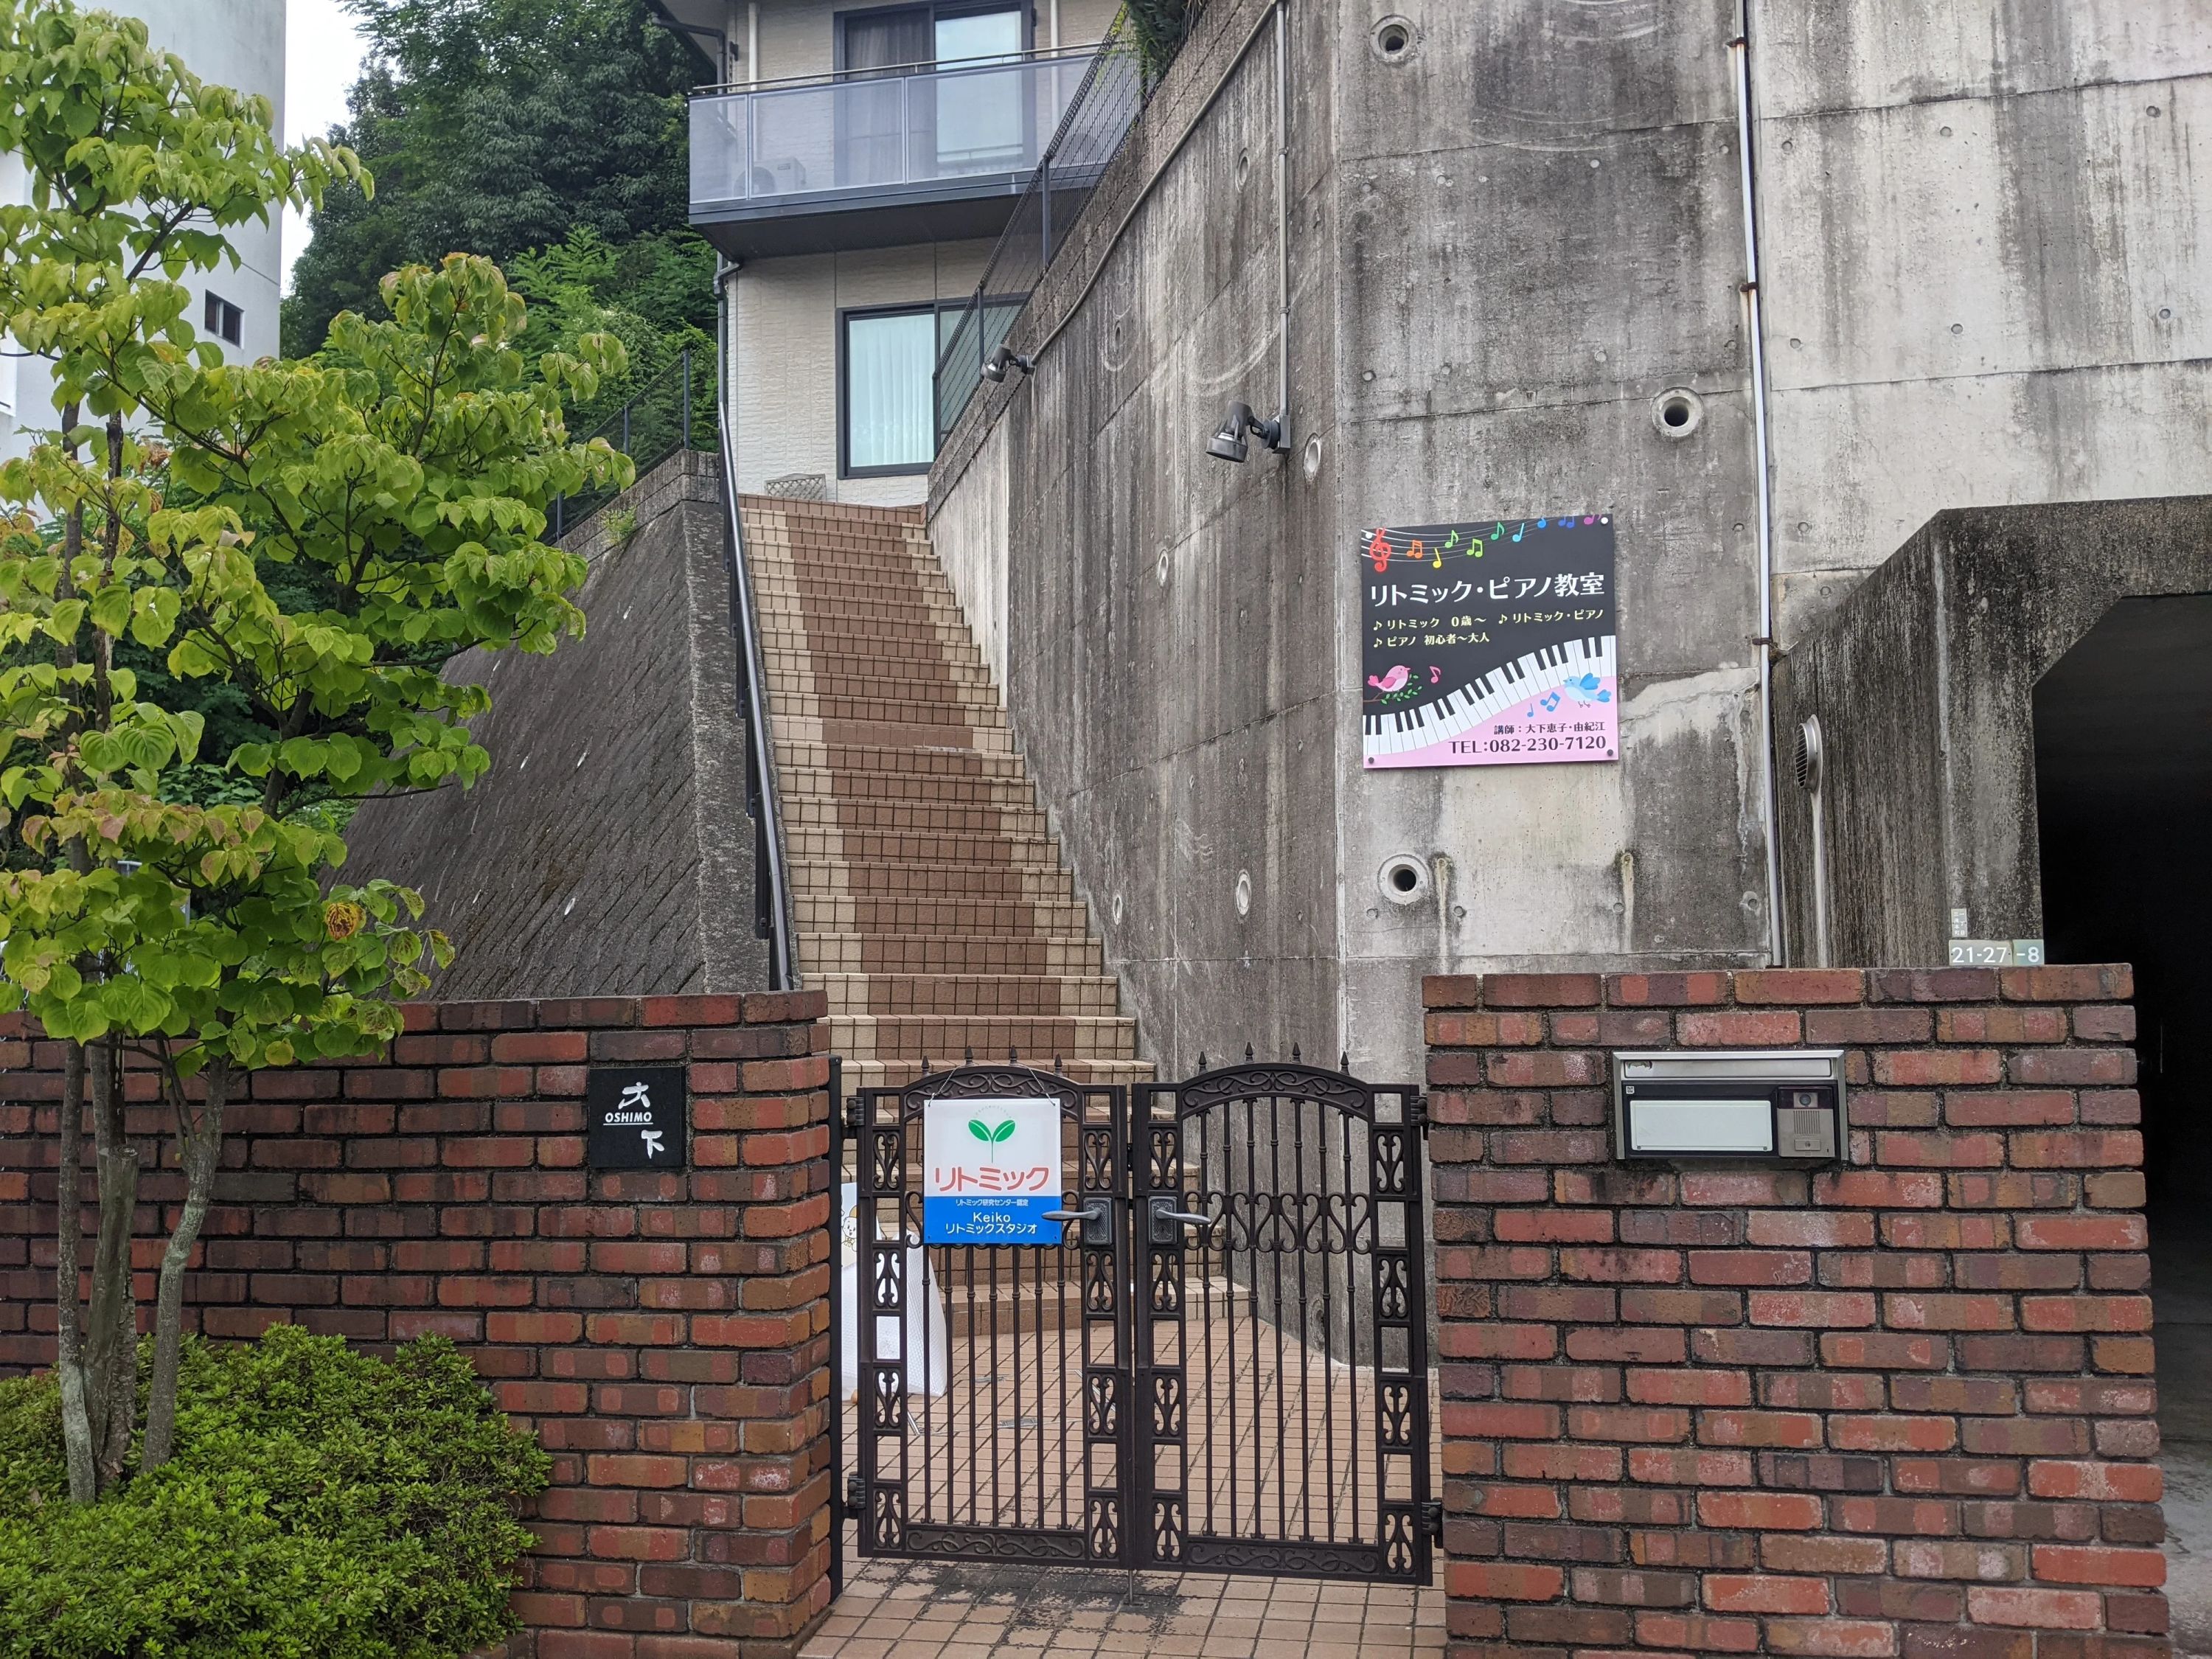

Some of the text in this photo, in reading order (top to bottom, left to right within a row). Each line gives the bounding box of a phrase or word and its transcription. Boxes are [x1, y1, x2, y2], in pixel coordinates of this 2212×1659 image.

[1371, 572, 1605, 607] リトミック・ピアノ教室
[1387, 617, 1440, 630] リトミック
[1513, 609, 1604, 624] リトミック・ピアノ
[1387, 636, 1417, 647] ピアノ
[605, 1111, 653, 1123] OSHIMO
[935, 1166, 1049, 1192] リトミック
[973, 1211, 1011, 1222] Keiko
[945, 1222, 1037, 1234] リトミックスタジオ
